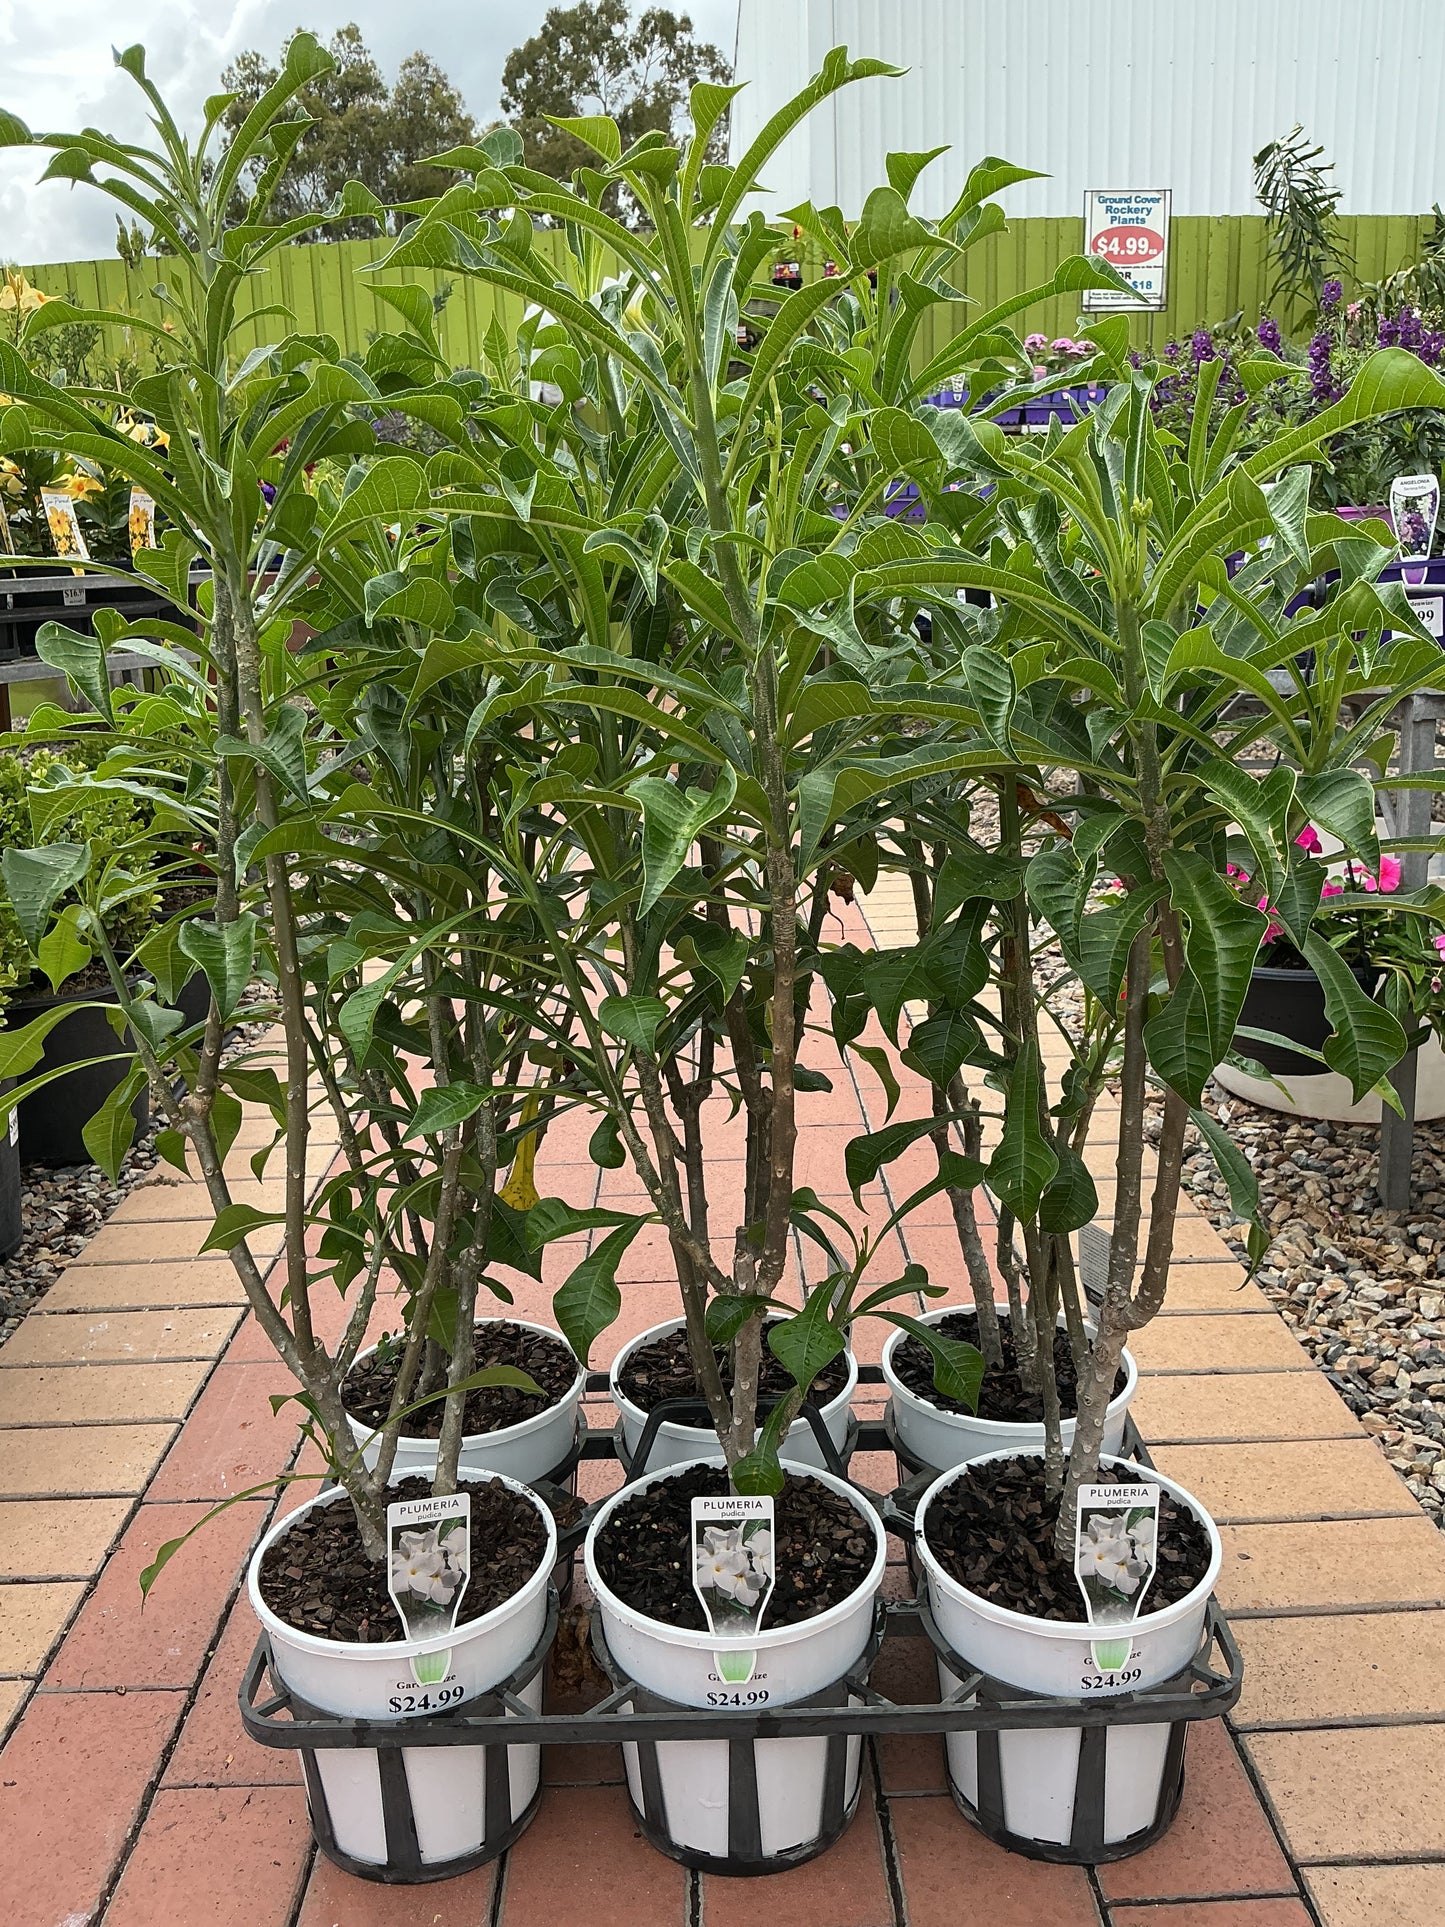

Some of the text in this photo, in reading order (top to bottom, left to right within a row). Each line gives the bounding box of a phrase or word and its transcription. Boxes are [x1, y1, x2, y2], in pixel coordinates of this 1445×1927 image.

[1098, 196, 1161, 204] Ground Cover
[1105, 205, 1152, 216] Rockery
[1110, 216, 1146, 224] Plants
[1090, 1488, 1149, 1498] PLUMERIA
[400, 1498, 460, 1516] PLUMERIA
[704, 1501, 763, 1510] PLUMERIA
[1106, 1498, 1132, 1506] pudica
[417, 1511, 442, 1522] pudica
[720, 1510, 746, 1518] pudica
[1081, 1668, 1142, 1690] $24.99
[389, 1686, 464, 1713] $24.99
[707, 1690, 769, 1706] $24.99
